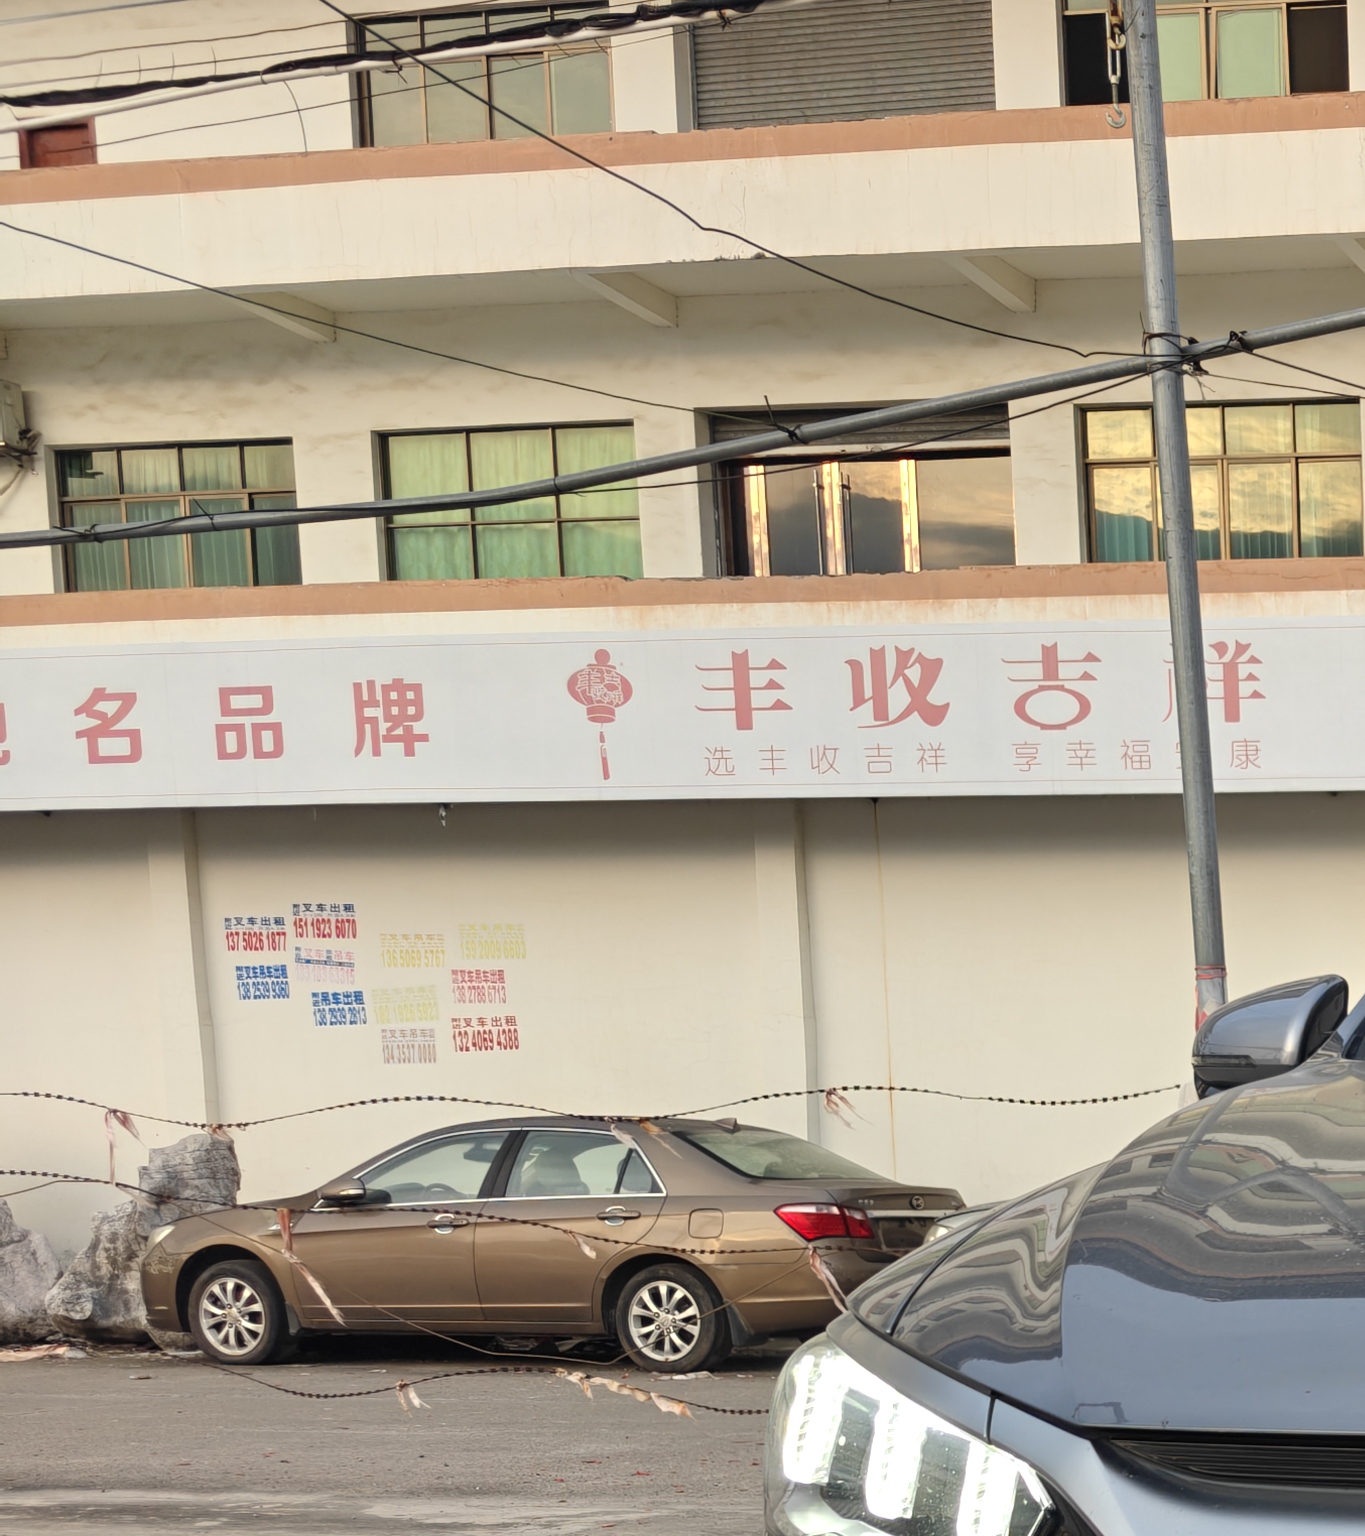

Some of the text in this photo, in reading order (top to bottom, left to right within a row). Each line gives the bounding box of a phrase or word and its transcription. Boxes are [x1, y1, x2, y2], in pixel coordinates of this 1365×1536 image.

[703, 741, 948, 777] 选丰收吉祥
[1011, 738, 1263, 772] 享幸福康
[293, 917, 357, 939] 151 1923 6070
[226, 931, 287, 952] 137 5026 1877
[381, 949, 446, 968] 136 5069 5767
[487, 985, 507, 1004] 6713
[452, 1028, 520, 1052] 132 4069 4388
